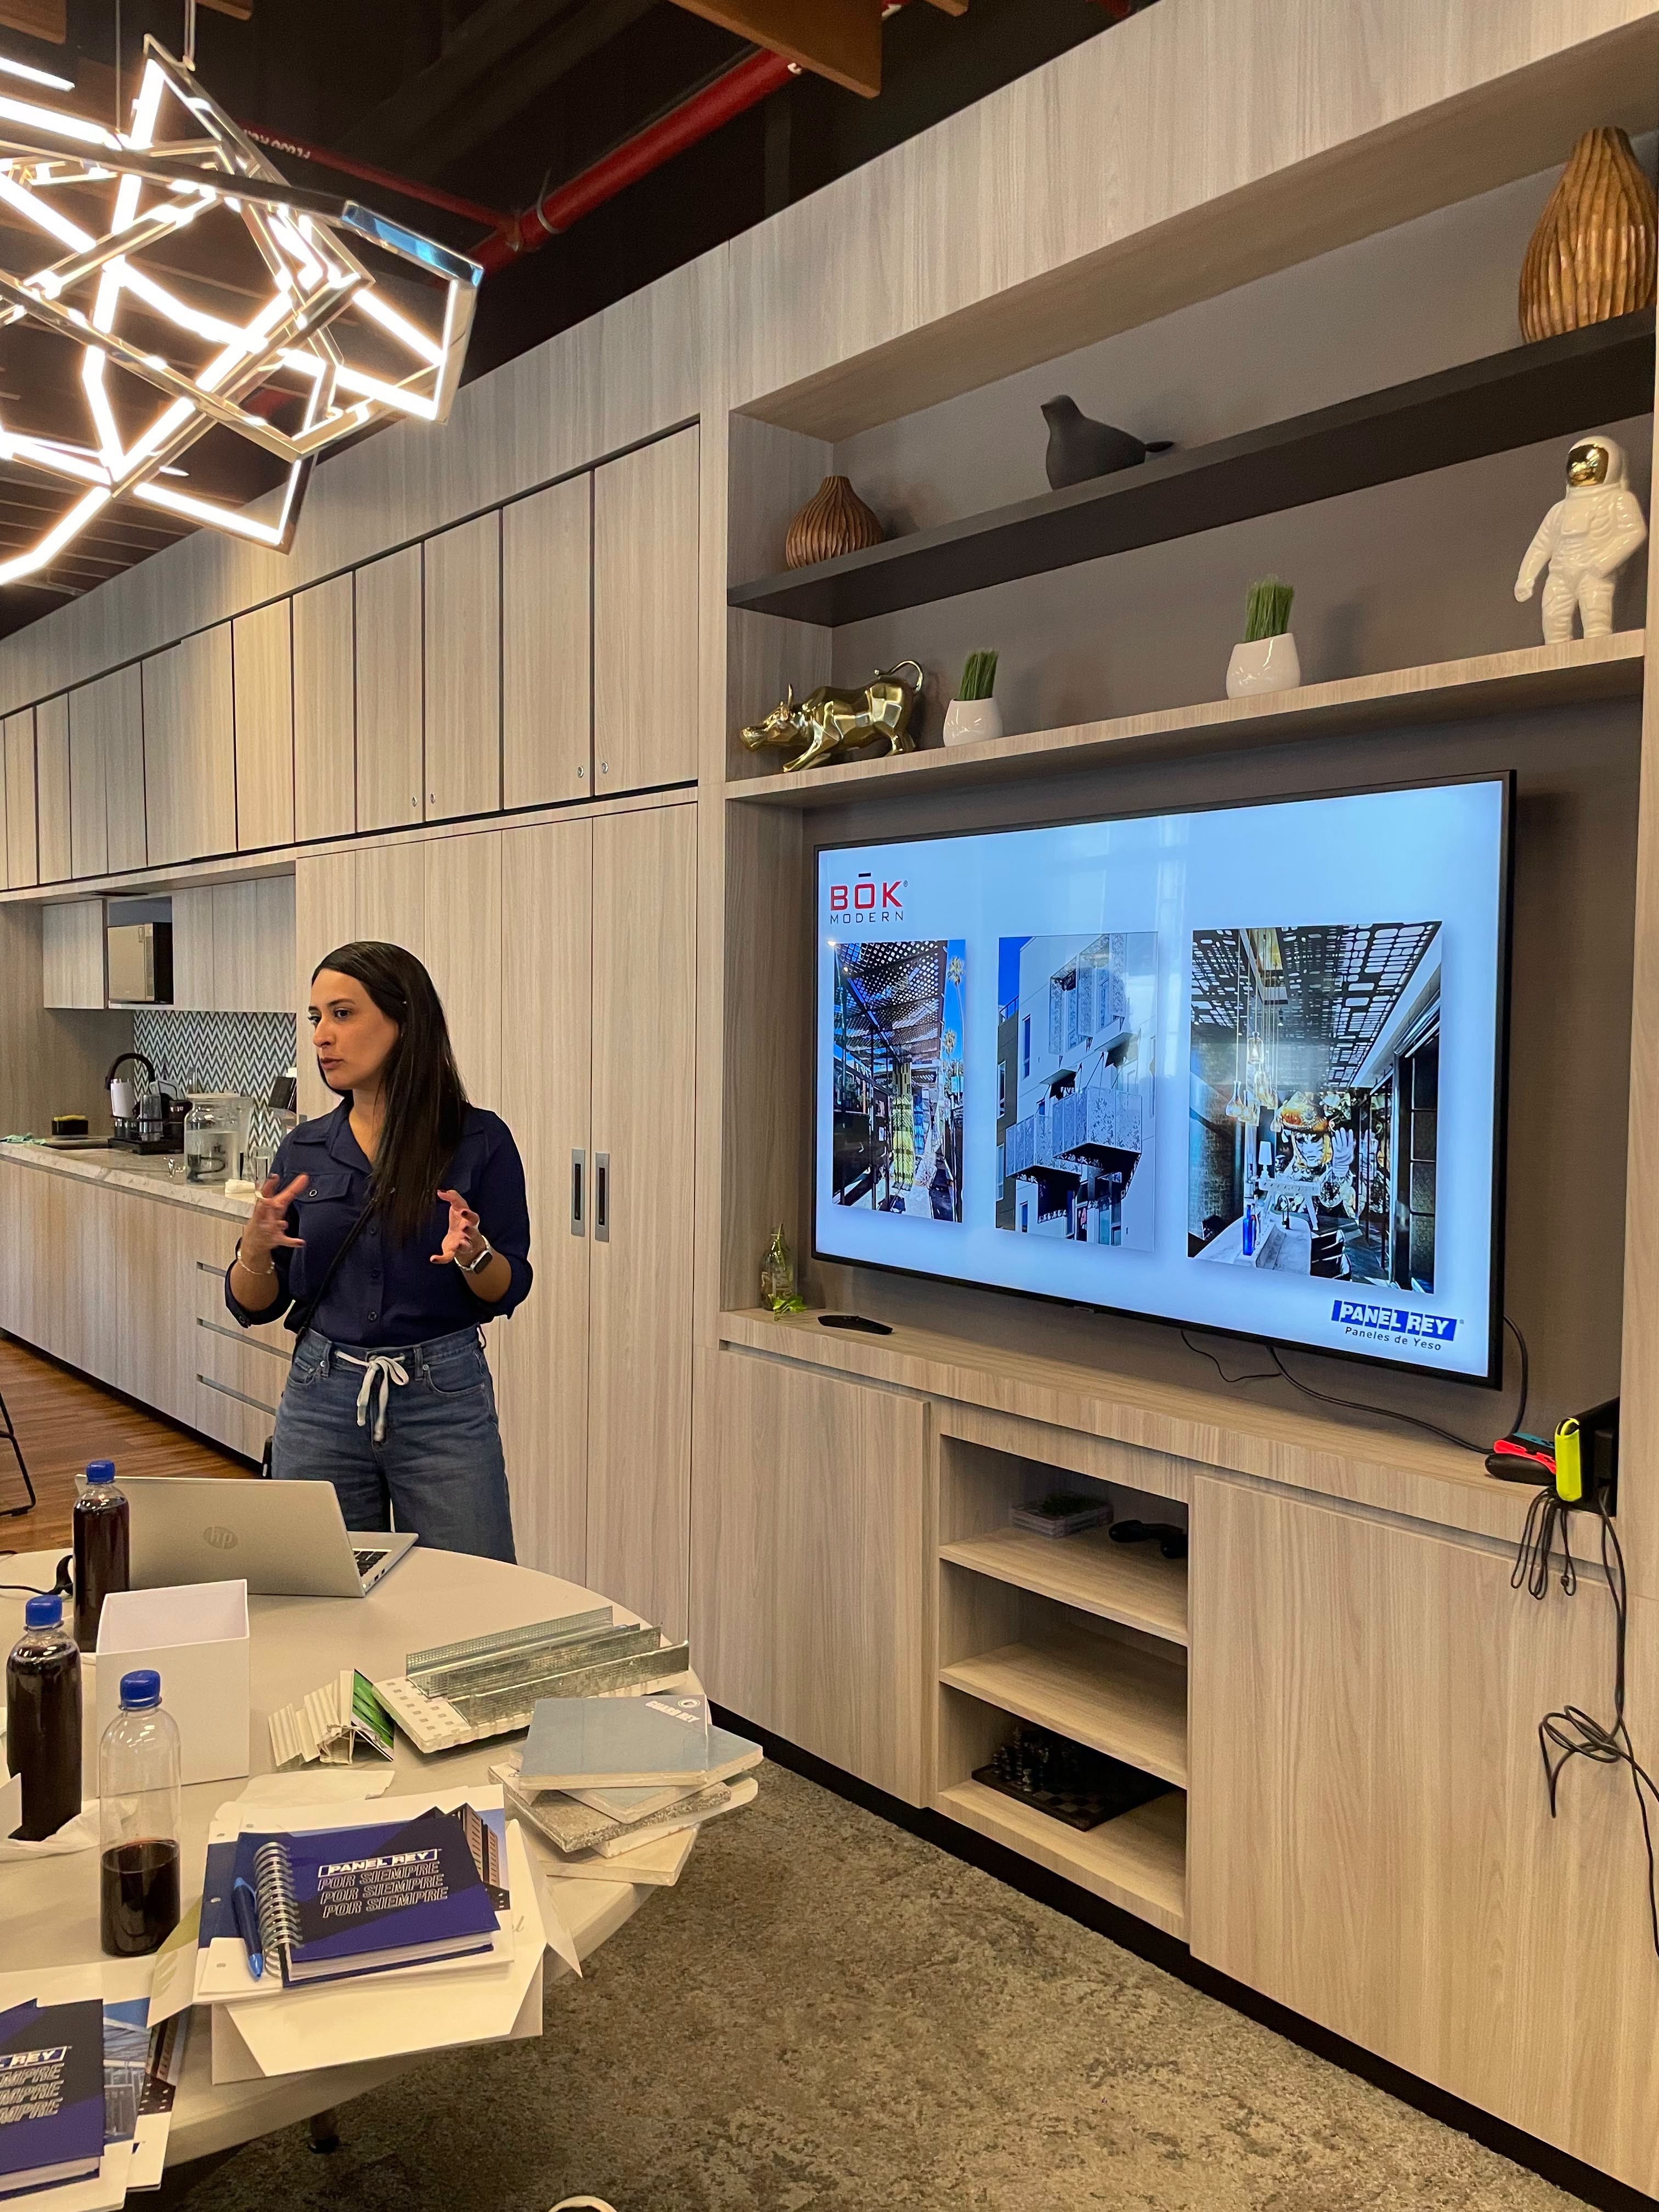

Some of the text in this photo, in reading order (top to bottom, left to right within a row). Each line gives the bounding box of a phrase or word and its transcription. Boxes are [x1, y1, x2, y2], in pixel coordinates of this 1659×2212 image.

[830, 911, 904, 924] MODERN
[1339, 1301, 1449, 1335] PANEL REY
[1345, 1327, 1441, 1351] Paneles de Yeso
[318, 1861, 440, 1892] POR SIEMPRE
[328, 1852, 429, 1876] PANEL REY
[320, 1874, 444, 1905] POR SIEMPRE
[323, 1886, 449, 1918] POR SIEMPRE
[9, 2050, 56, 2069] REY
[0, 2063, 65, 2088] MPRE
[0, 2080, 64, 2106] MPRE
[0, 2097, 64, 2124] MPRE
